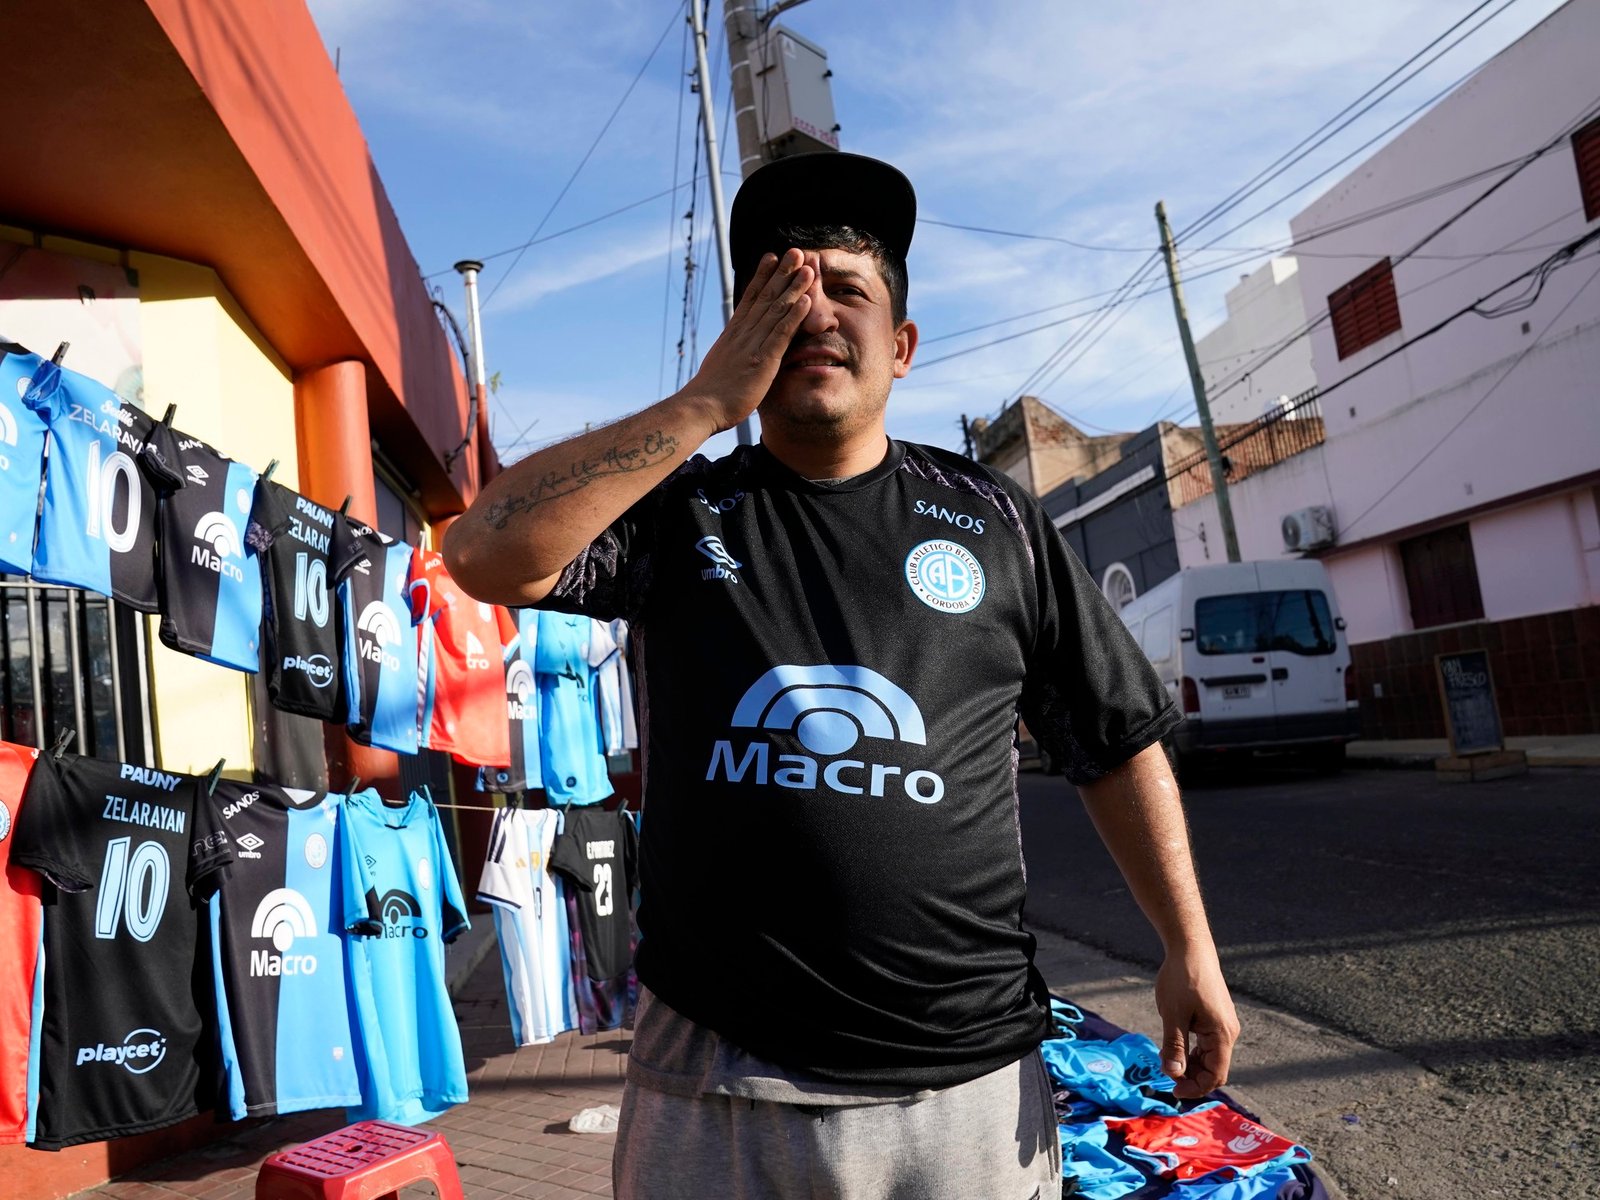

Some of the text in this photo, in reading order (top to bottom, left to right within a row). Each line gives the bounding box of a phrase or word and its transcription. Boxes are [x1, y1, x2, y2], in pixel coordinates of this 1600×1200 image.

[68, 404, 146, 455] ZELARAY
[86, 440, 142, 554] 10
[296, 496, 334, 529] PAUNY
[697, 488, 745, 515] SNOS
[914, 500, 986, 535] SANOS
[191, 545, 244, 583] Macro
[701, 564, 738, 584] umbro
[909, 543, 981, 594] CLUB ATLETICO BELGRANO
[294, 552, 330, 628] 10
[925, 594, 970, 609] CORDOBA
[120, 763, 182, 792] PAUNY
[704, 740, 945, 805] Macro
[102, 795, 186, 834] ZELARAYAN
[223, 791, 260, 820] SANOS
[238, 851, 261, 859] umbro
[95, 836, 171, 943] 10
[250, 950, 317, 977] Macro
[76, 1041, 161, 1066] playcet
